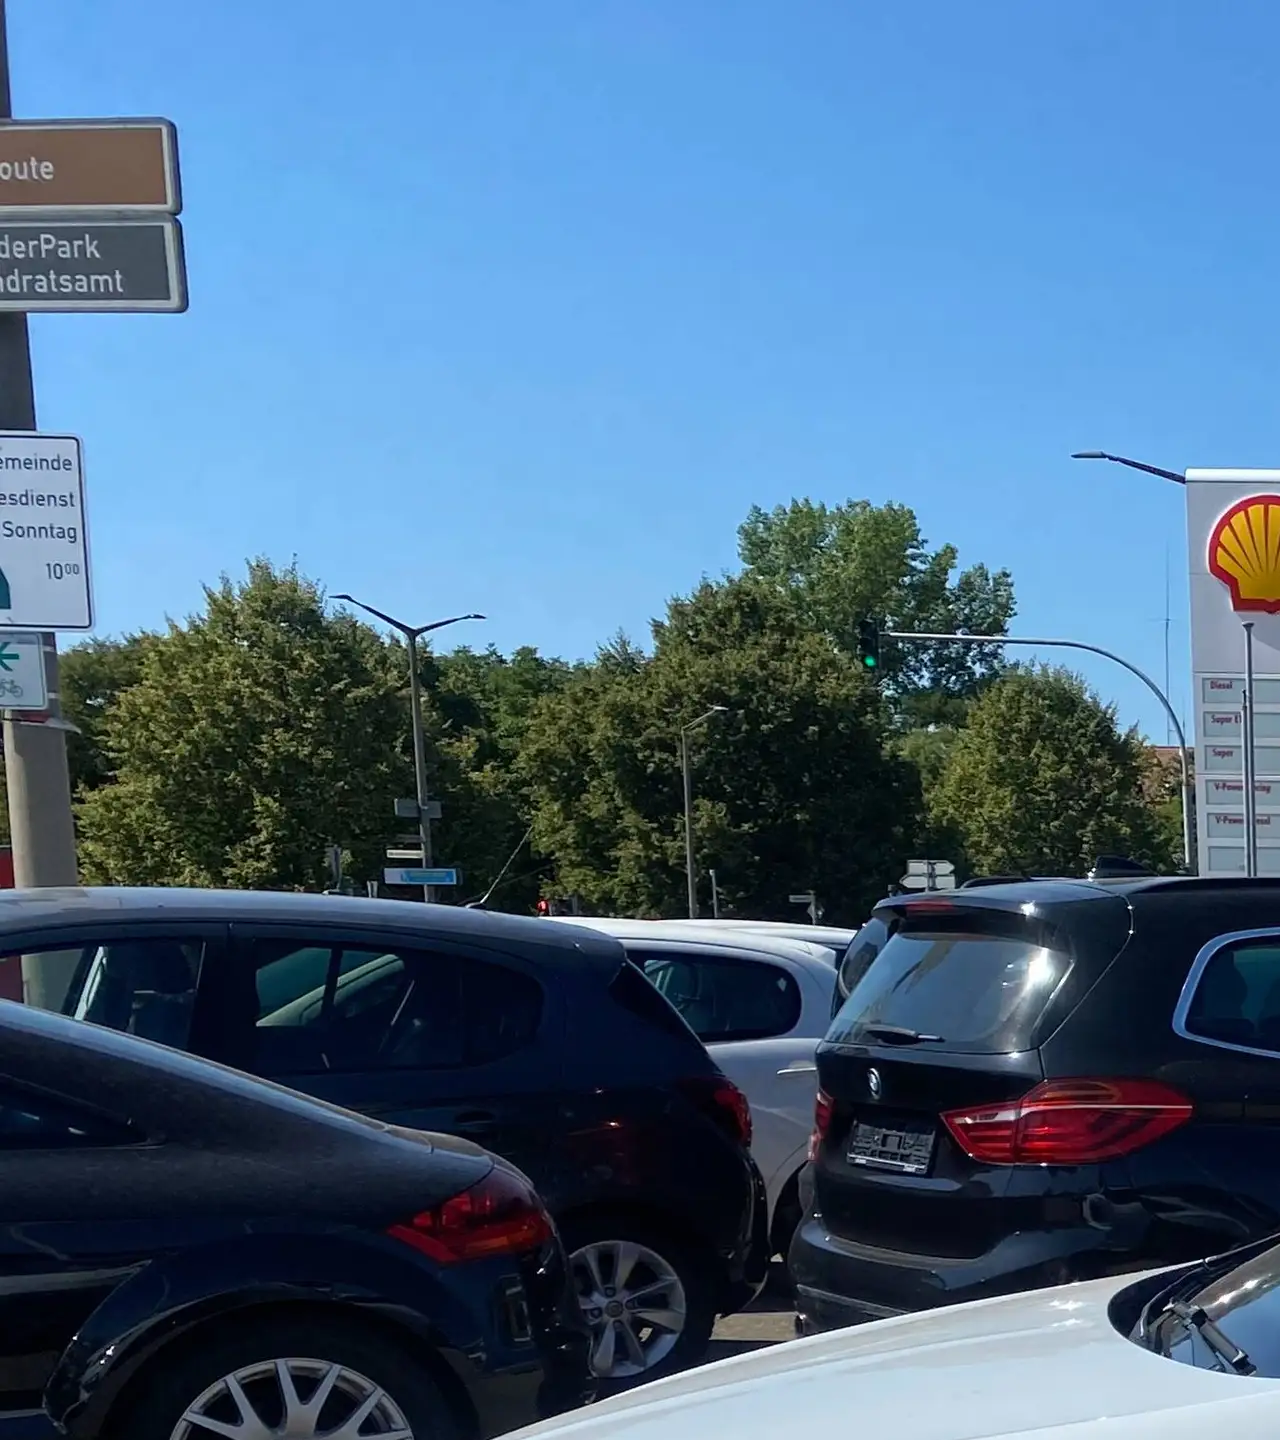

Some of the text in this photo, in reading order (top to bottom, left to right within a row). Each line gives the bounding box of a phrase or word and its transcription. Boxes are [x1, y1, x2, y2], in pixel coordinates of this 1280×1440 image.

[0, 233, 101, 259] derPark
[0, 268, 124, 293] dratsamt
[2, 520, 77, 544] Sonntag
